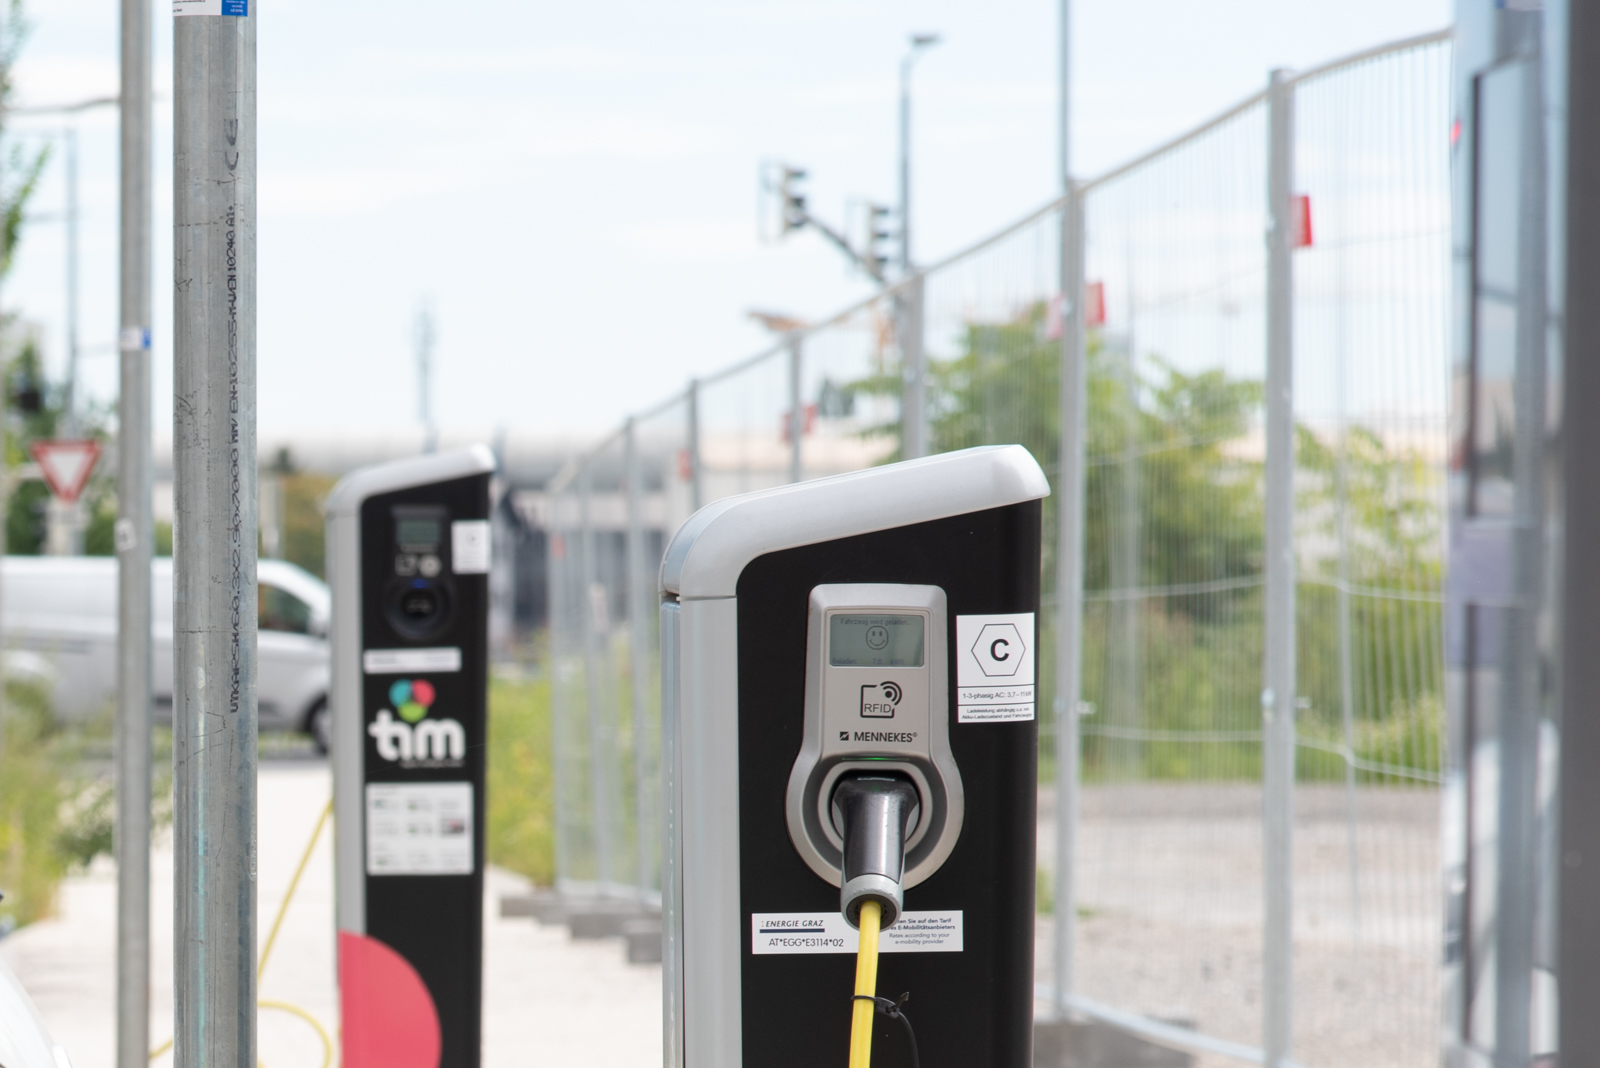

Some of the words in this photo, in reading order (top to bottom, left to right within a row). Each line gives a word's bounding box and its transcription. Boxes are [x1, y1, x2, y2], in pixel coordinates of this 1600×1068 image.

[989, 638, 1010, 662] C
[863, 703, 892, 713] RFID
[367, 707, 466, 762] tim
[765, 920, 800, 928] ENERGIE
[802, 919, 824, 927] GRAZ
